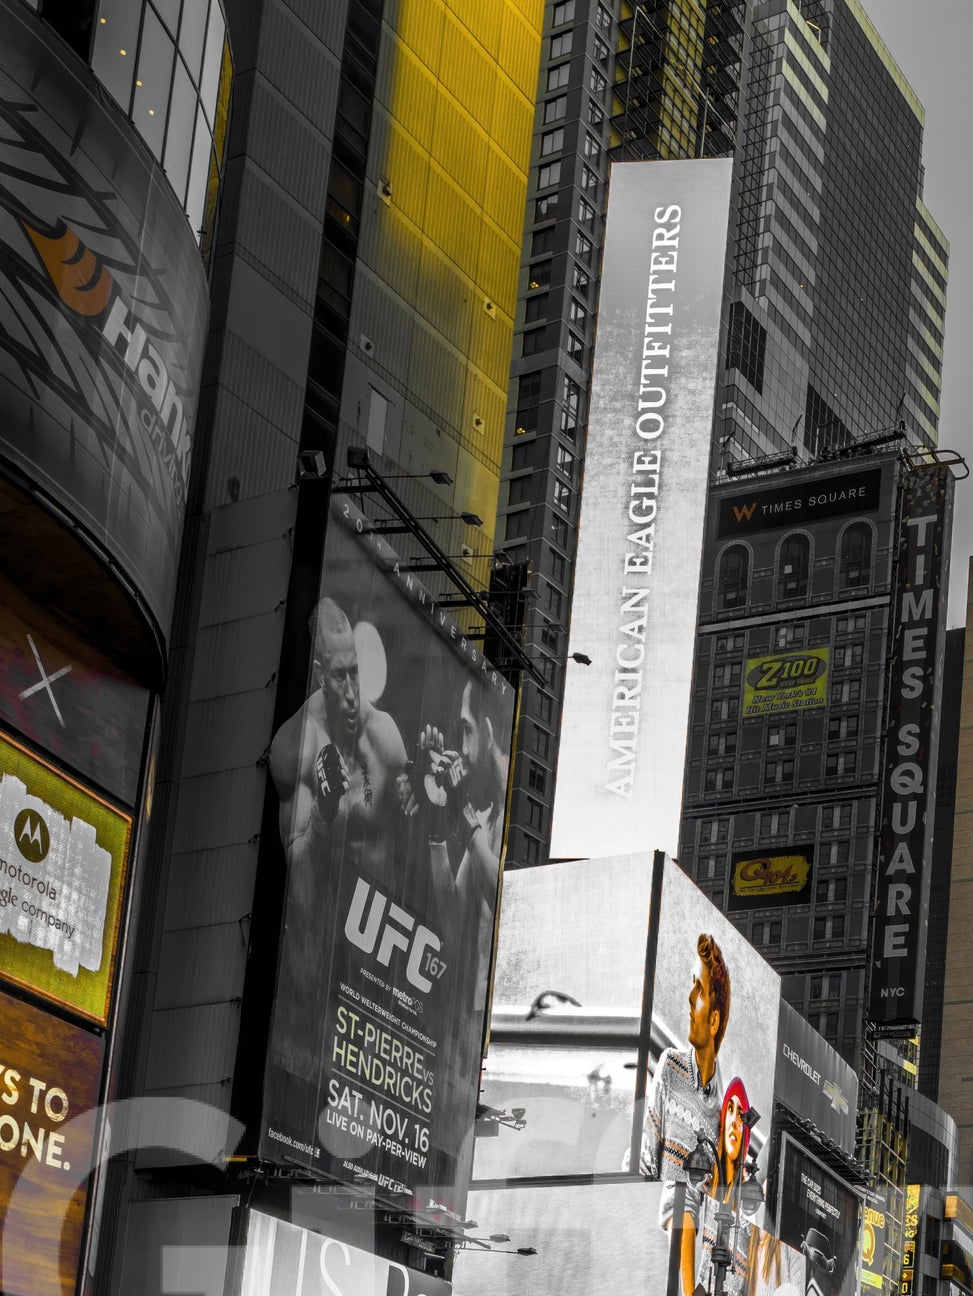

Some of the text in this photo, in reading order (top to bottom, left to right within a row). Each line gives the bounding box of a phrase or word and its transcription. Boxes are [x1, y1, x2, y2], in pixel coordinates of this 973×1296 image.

[604, 203, 683, 800] AMERICAN EAGLE OUTFITTERS
[732, 486, 867, 523] W TIMES SQUARE
[392, 561, 507, 695] ANNIVERSARY
[901, 514, 938, 699] TIMES
[755, 656, 821, 691] Z100
[761, 701, 791, 712] Music
[791, 697, 824, 706] Station
[883, 723, 924, 959] SQUARE
[21, 900, 76, 939] company
[344, 877, 447, 994] UFC 167
[340, 982, 361, 1001] WORLD
[401, 1021, 438, 1048] CHAMPIONSHIP
[880, 987, 905, 999] NYC
[332, 1036, 432, 1115] HENDRICKS
[335, 1006, 424, 1081] ST-PIERRE
[782, 1042, 822, 1086] CHEVROLET
[29, 1076, 69, 1123] TO
[327, 1079, 430, 1153] SAT. NOV. 16
[326, 1110, 428, 1169] LIVE ON PAY-PER-VIEW
